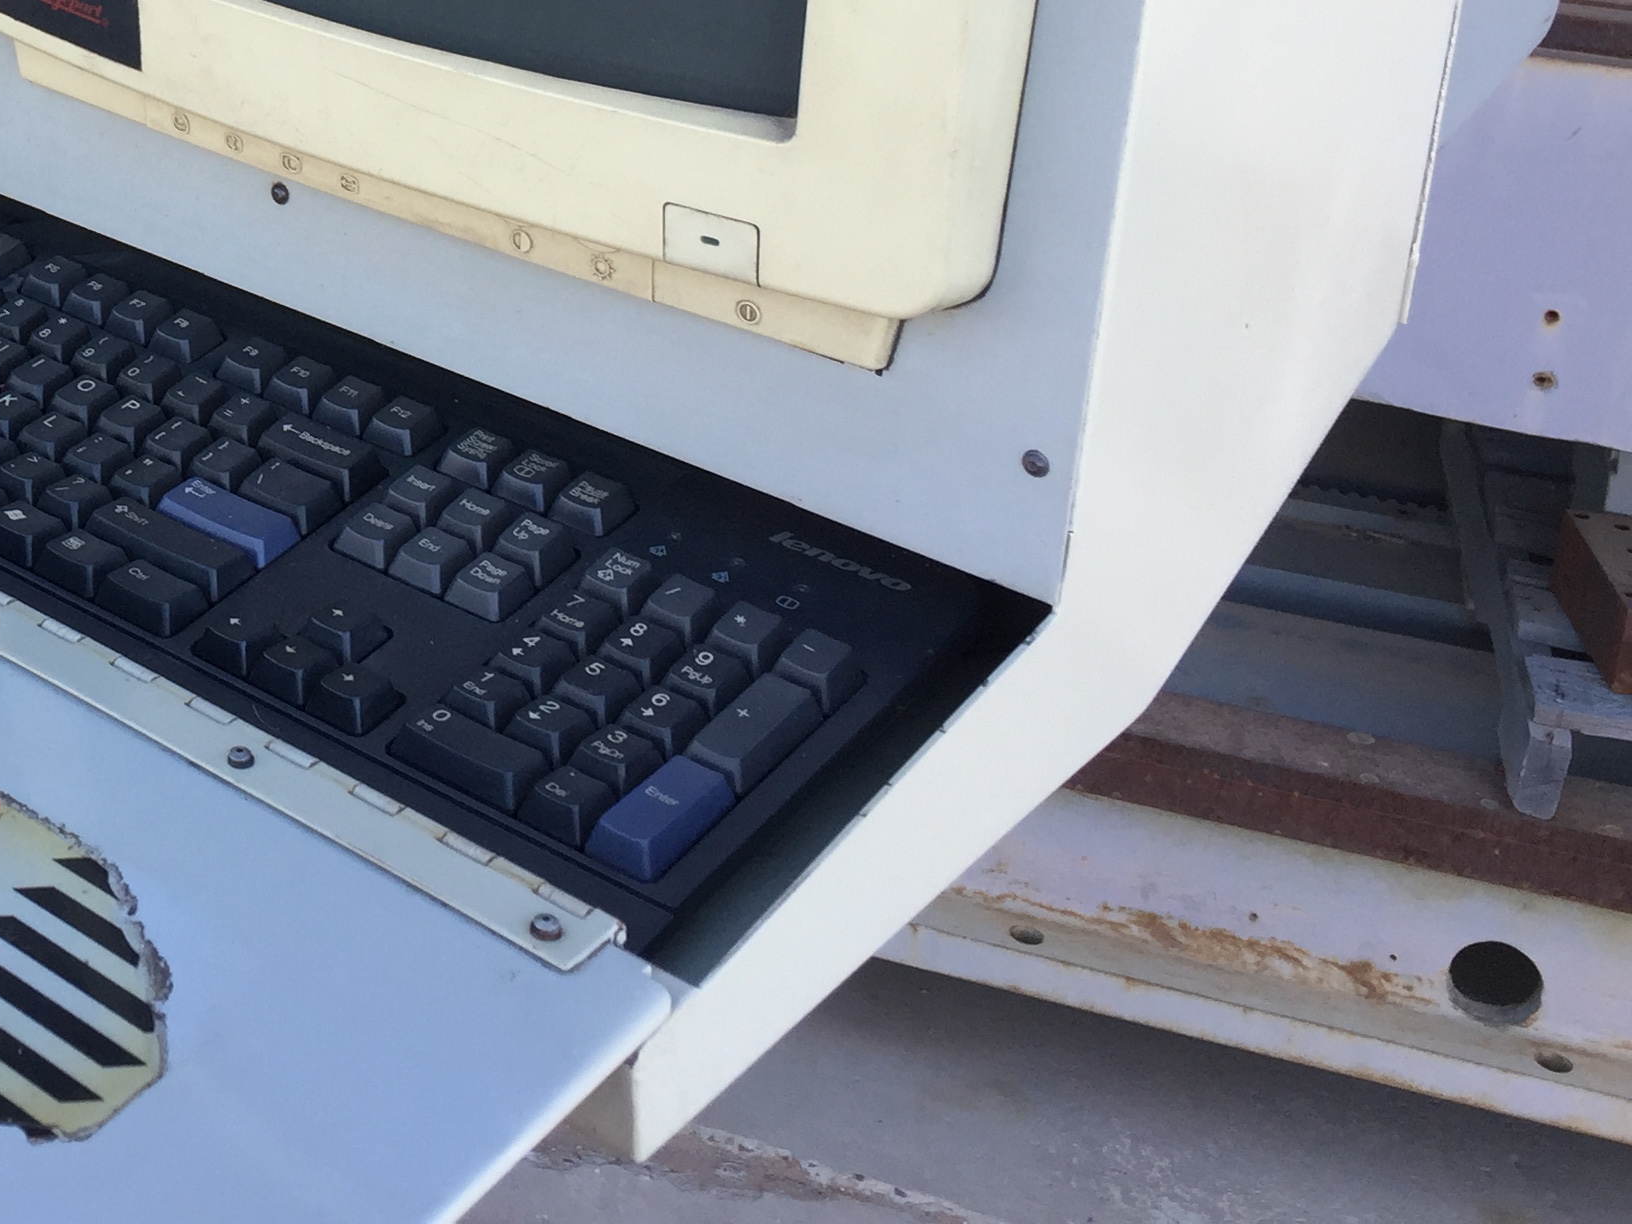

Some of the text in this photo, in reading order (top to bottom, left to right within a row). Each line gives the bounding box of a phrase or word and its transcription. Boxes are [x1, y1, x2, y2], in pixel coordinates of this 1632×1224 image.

[44, 262, 61, 273] F5
[88, 280, 103, 291] F6
[129, 298, 146, 308] F7
[173, 317, 190, 328] F8
[38, 328, 52, 338] 8
[82, 347, 95, 357] 9
[242, 345, 259, 356] F9
[290, 366, 311, 378] F10
[339, 385, 359, 397] F11
[120, 399, 141, 410] P
[390, 406, 412, 418] F12
[42, 414, 57, 428] L
[298, 430, 351, 456] Backspace
[190, 479, 217, 495] Enter
[406, 474, 436, 492] Insert
[459, 498, 491, 516] Home
[124, 511, 149, 526] Shift
[363, 512, 394, 530] Delete
[512, 526, 529, 540] Up
[521, 518, 550, 536] Page
[418, 537, 442, 553] End
[605, 559, 633, 576] Lock
[612, 552, 641, 569] Num
[769, 531, 912, 591] lenovo
[128, 567, 150, 580] Ctrl
[479, 559, 508, 577] Page
[469, 567, 501, 584] Down
[566, 594, 585, 607] 7
[550, 608, 585, 628] Home
[630, 622, 648, 636] 8
[522, 636, 541, 647] 4
[694, 651, 714, 666] 9
[585, 662, 606, 675] 5
[680, 665, 713, 685] PgUp
[481, 672, 495, 682] 1
[462, 680, 487, 696] End
[651, 693, 671, 706] 6
[538, 700, 560, 714] 2
[607, 730, 628, 744] 3
[544, 782, 568, 797] Del
[644, 786, 679, 806] Enter
